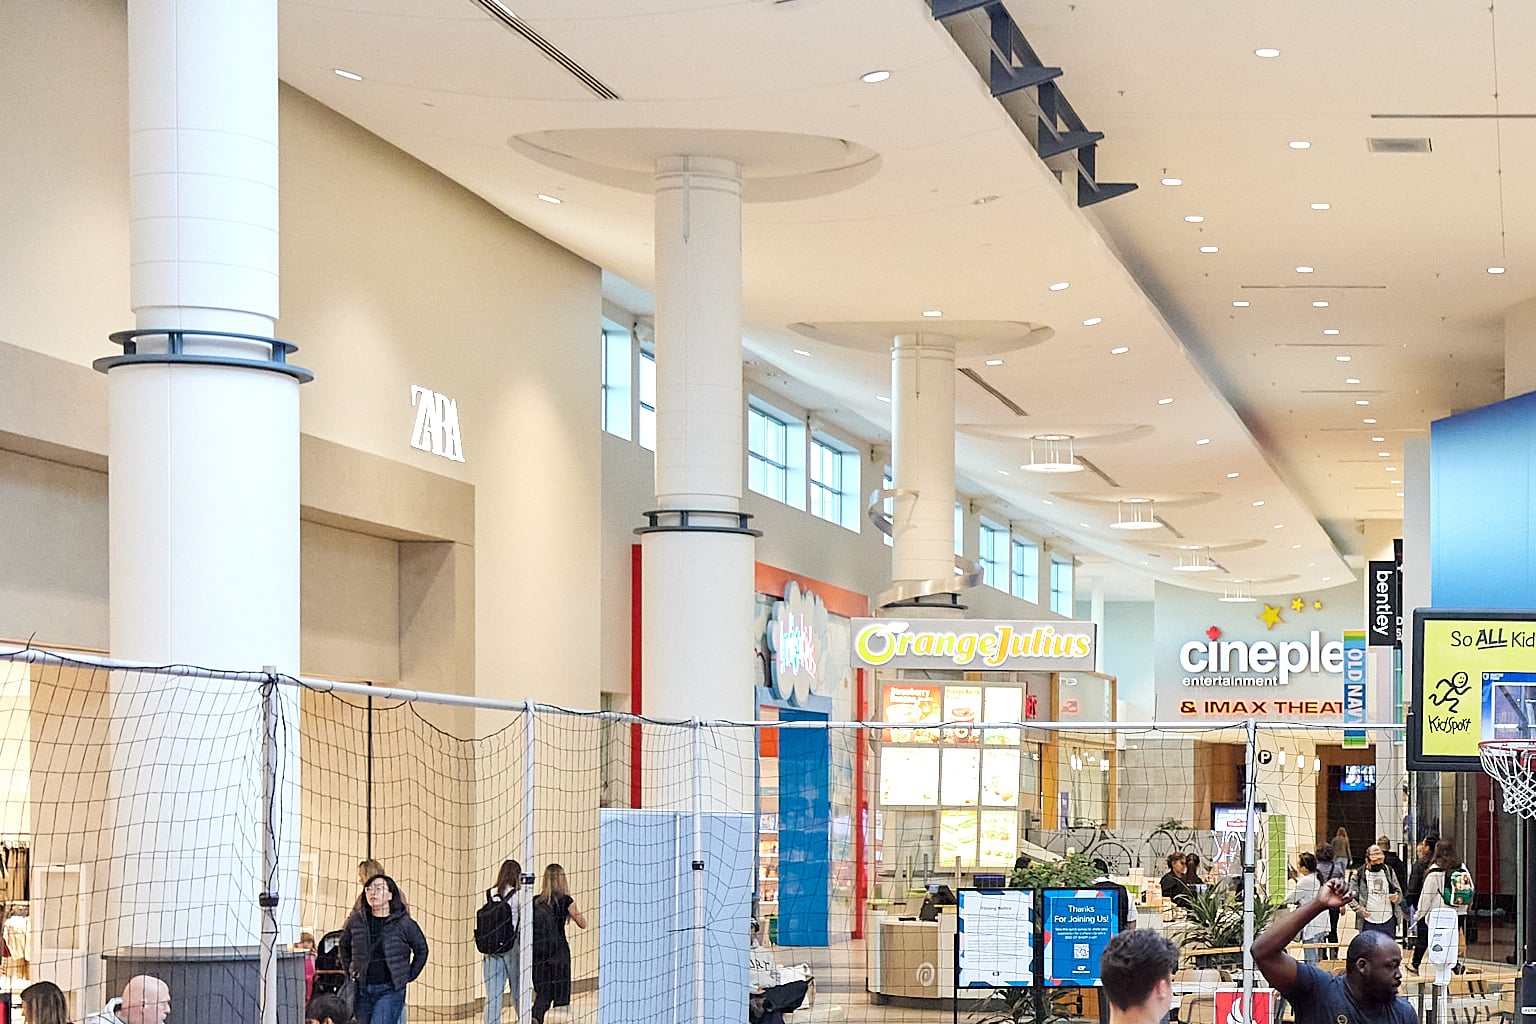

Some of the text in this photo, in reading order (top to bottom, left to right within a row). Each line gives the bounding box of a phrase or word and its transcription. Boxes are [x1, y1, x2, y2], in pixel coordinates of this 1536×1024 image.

[410, 384, 466, 463] ZARA
[1373, 570, 1394, 636] bentley
[1450, 630, 1473, 647] So
[1475, 628, 1508, 648] ALL
[1179, 626, 1344, 685] cineple
[1347, 648, 1363, 682] OLD
[1182, 675, 1278, 687] entertainment
[1180, 701, 1344, 714] & IMAX THEAT
[1428, 715, 1472, 735] KidSport
[1068, 904, 1095, 913] Thanks
[1054, 915, 1109, 925] For Joining Us!
